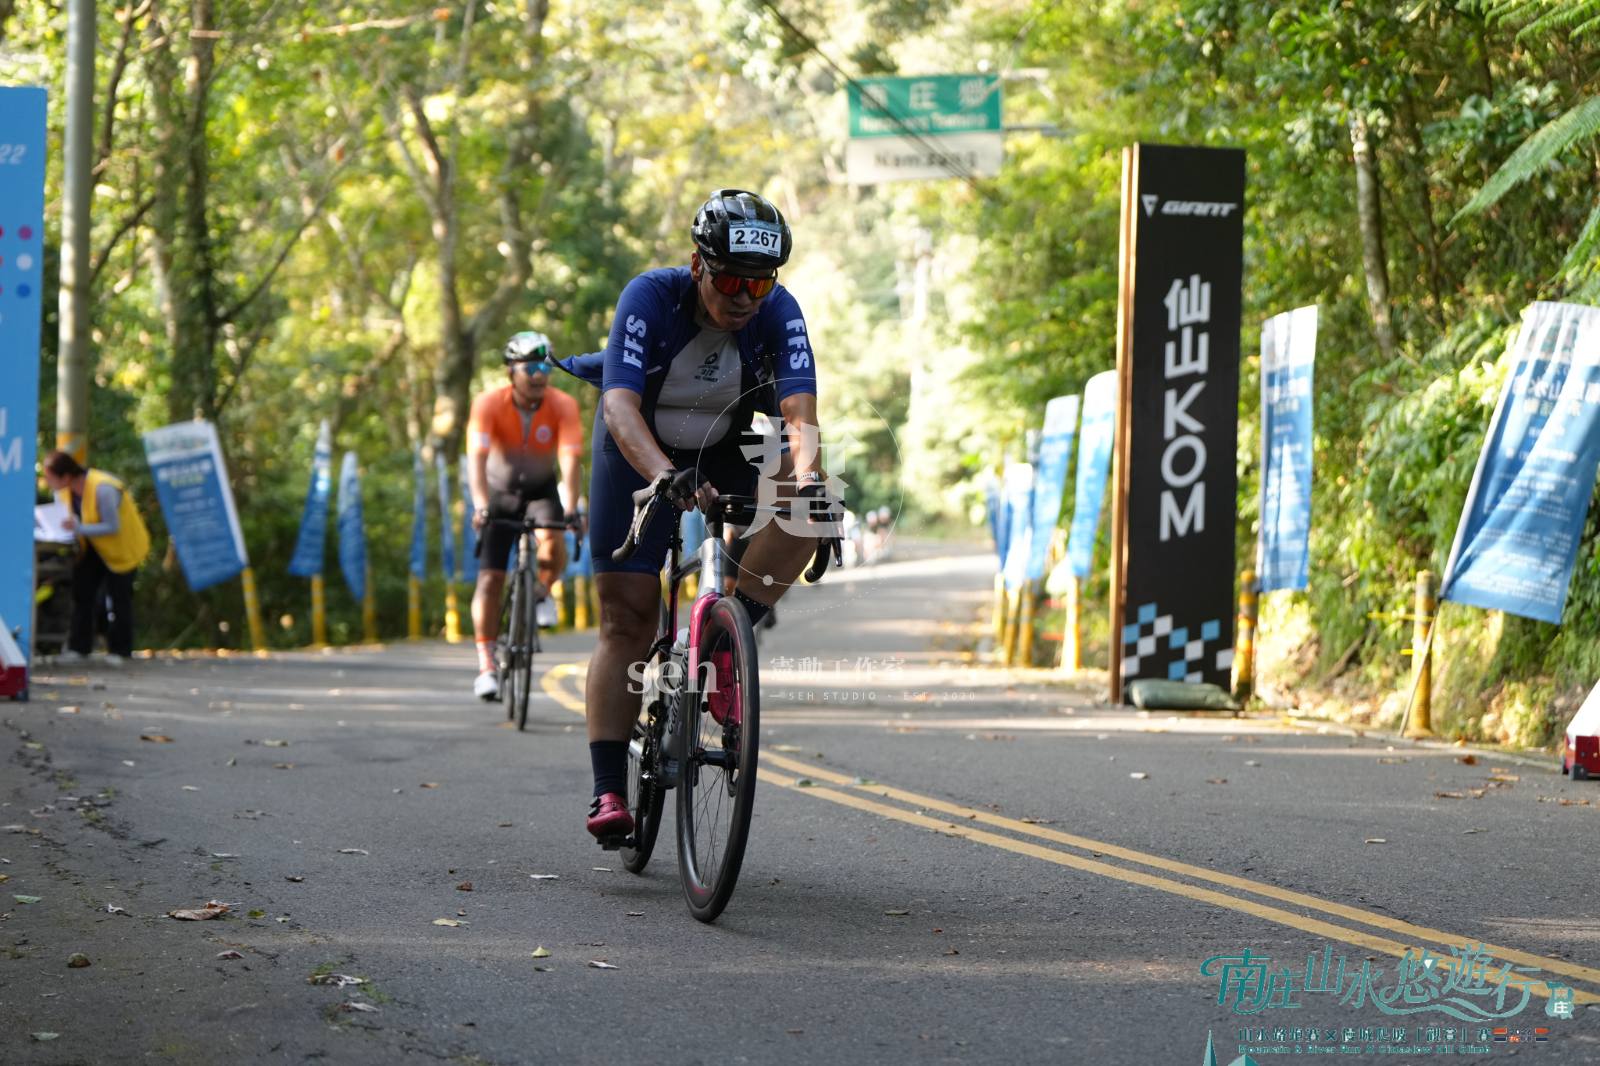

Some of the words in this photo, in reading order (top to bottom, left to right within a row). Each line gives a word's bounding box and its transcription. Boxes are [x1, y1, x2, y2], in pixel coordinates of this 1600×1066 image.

[1160, 200, 1239, 217] GIANT
[735, 229, 779, 249] 2267
[623, 314, 647, 369] FFS
[785, 318, 810, 370] FFS
